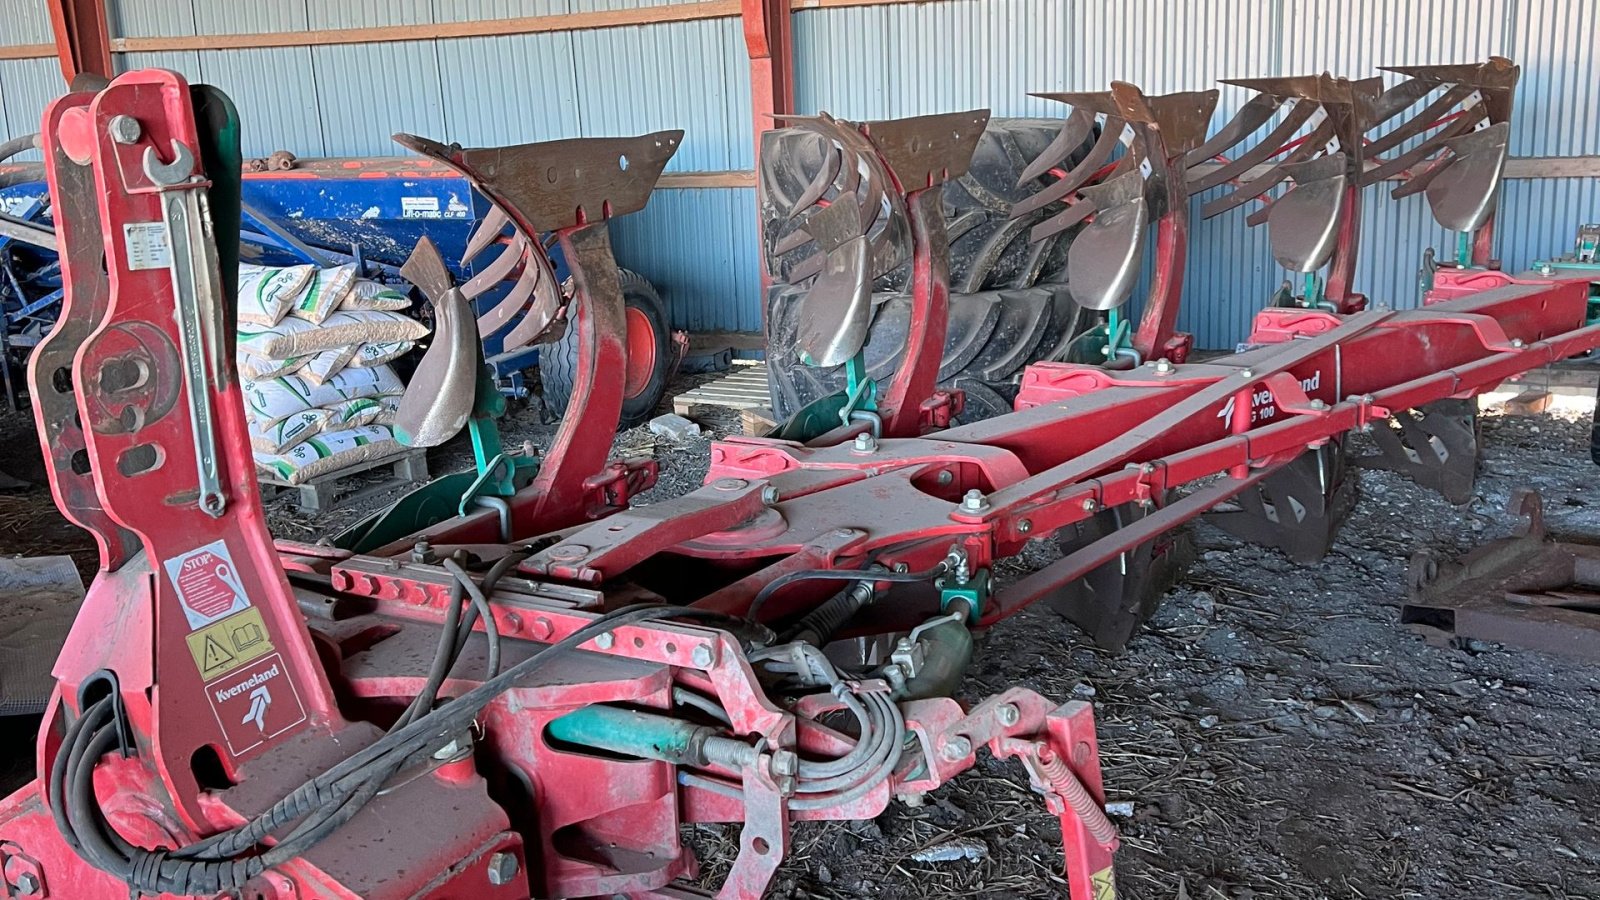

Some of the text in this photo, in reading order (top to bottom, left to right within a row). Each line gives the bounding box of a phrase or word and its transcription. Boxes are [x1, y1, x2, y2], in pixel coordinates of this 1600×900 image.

[1260, 406, 1275, 420] 100
[184, 553, 214, 572] STOP!
[215, 664, 280, 703] Kverneland
